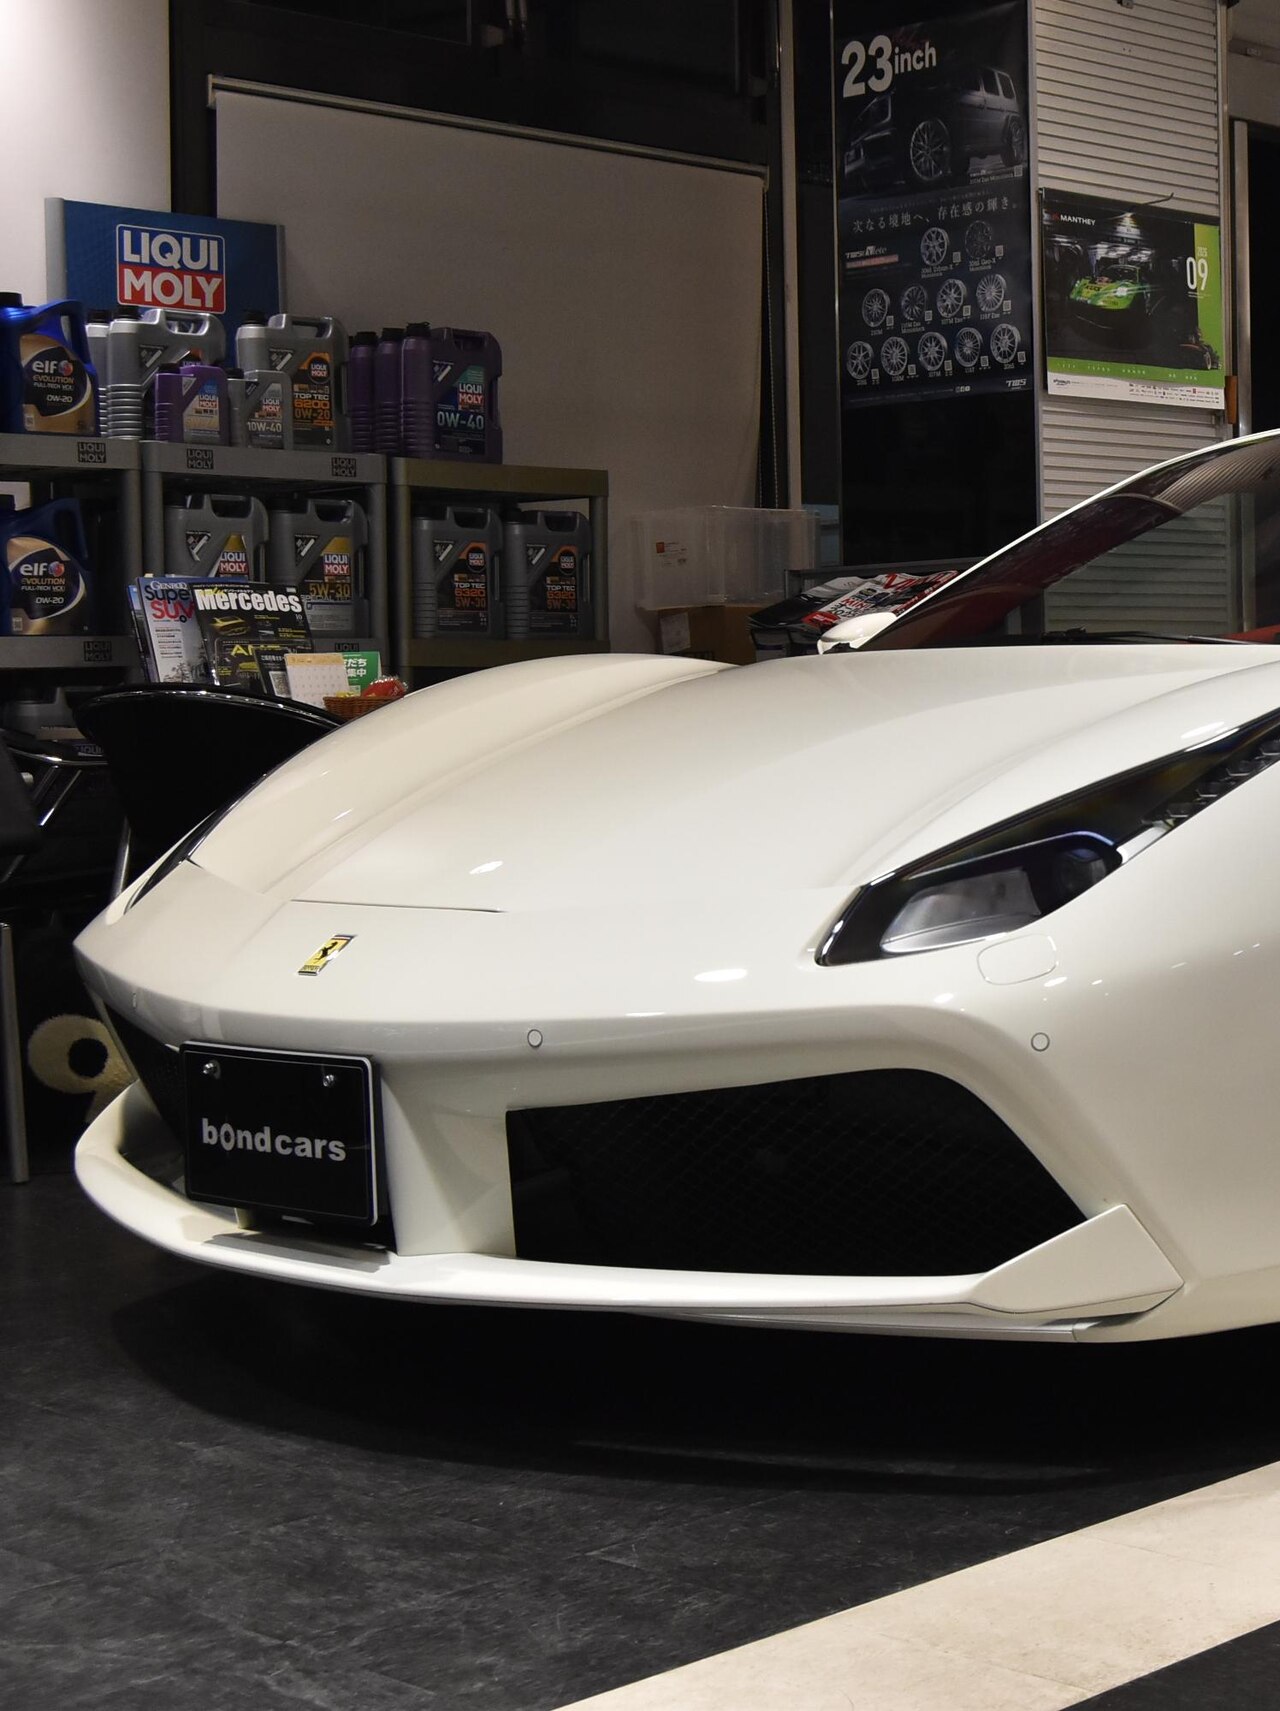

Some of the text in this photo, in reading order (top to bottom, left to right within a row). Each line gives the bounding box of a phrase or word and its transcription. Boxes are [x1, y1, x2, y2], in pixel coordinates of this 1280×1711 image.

[1060, 214, 1096, 226] MANTHEY
[123, 230, 219, 271] LIQUI
[1186, 256, 1208, 291] 09
[123, 268, 222, 308] MOLY
[32, 360, 58, 374] elf
[32, 375, 75, 384] EVOLUTION
[459, 383, 482, 394] LIQUI
[46, 394, 73, 403] 0W-20
[459, 393, 483, 404] MOLY
[294, 400, 330, 409] 6200
[294, 408, 331, 420] 0W-20
[437, 410, 484, 430] 0W-40
[247, 421, 282, 433] 10W-40
[78, 442, 105, 453] LIQUI
[78, 452, 106, 463] MOLY
[188, 449, 213, 459] LIQUI
[187, 459, 213, 469] MOLY
[332, 467, 356, 477] MOLY
[221, 552, 245, 562] LIQUI
[324, 554, 348, 564] LIQUI
[20, 562, 48, 576] elf
[220, 562, 247, 572] MOLY
[325, 564, 349, 574] MOLY
[21, 577, 66, 585] EVOLUTION
[144, 585, 192, 604] Supe
[309, 584, 351, 598] 5W-30
[454, 589, 486, 597] 6320
[547, 591, 575, 599] 6320
[35, 596, 65, 604] 0W-20
[194, 588, 303, 613] Mercedes
[455, 597, 486, 608] 5W-30
[151, 600, 196, 619] SUV
